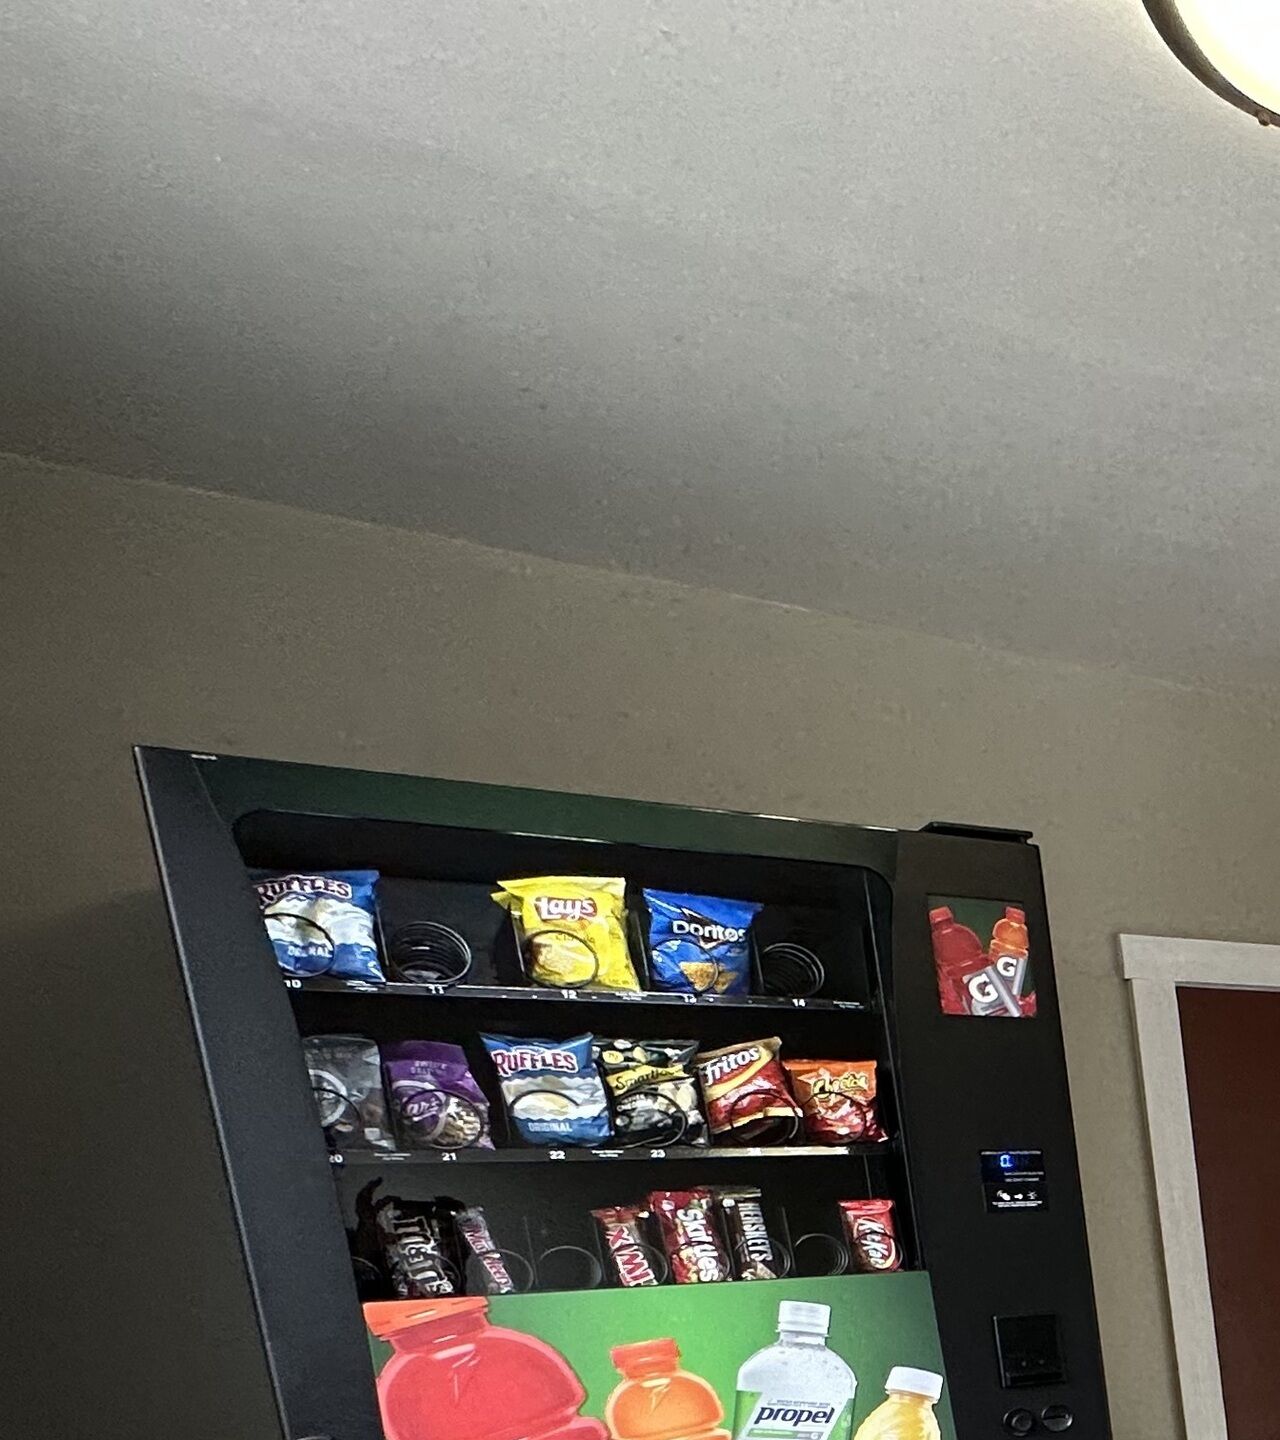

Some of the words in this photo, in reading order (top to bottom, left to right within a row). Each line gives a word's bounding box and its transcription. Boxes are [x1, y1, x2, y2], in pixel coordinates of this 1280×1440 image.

[672, 919, 747, 943] Doritos
[969, 973, 999, 1003] G
[492, 1048, 578, 1077] RUFFLES
[704, 1047, 761, 1085] Fritos
[442, 1152, 457, 1161] 21
[550, 1150, 566, 1160] 22
[754, 1406, 836, 1427] propel
